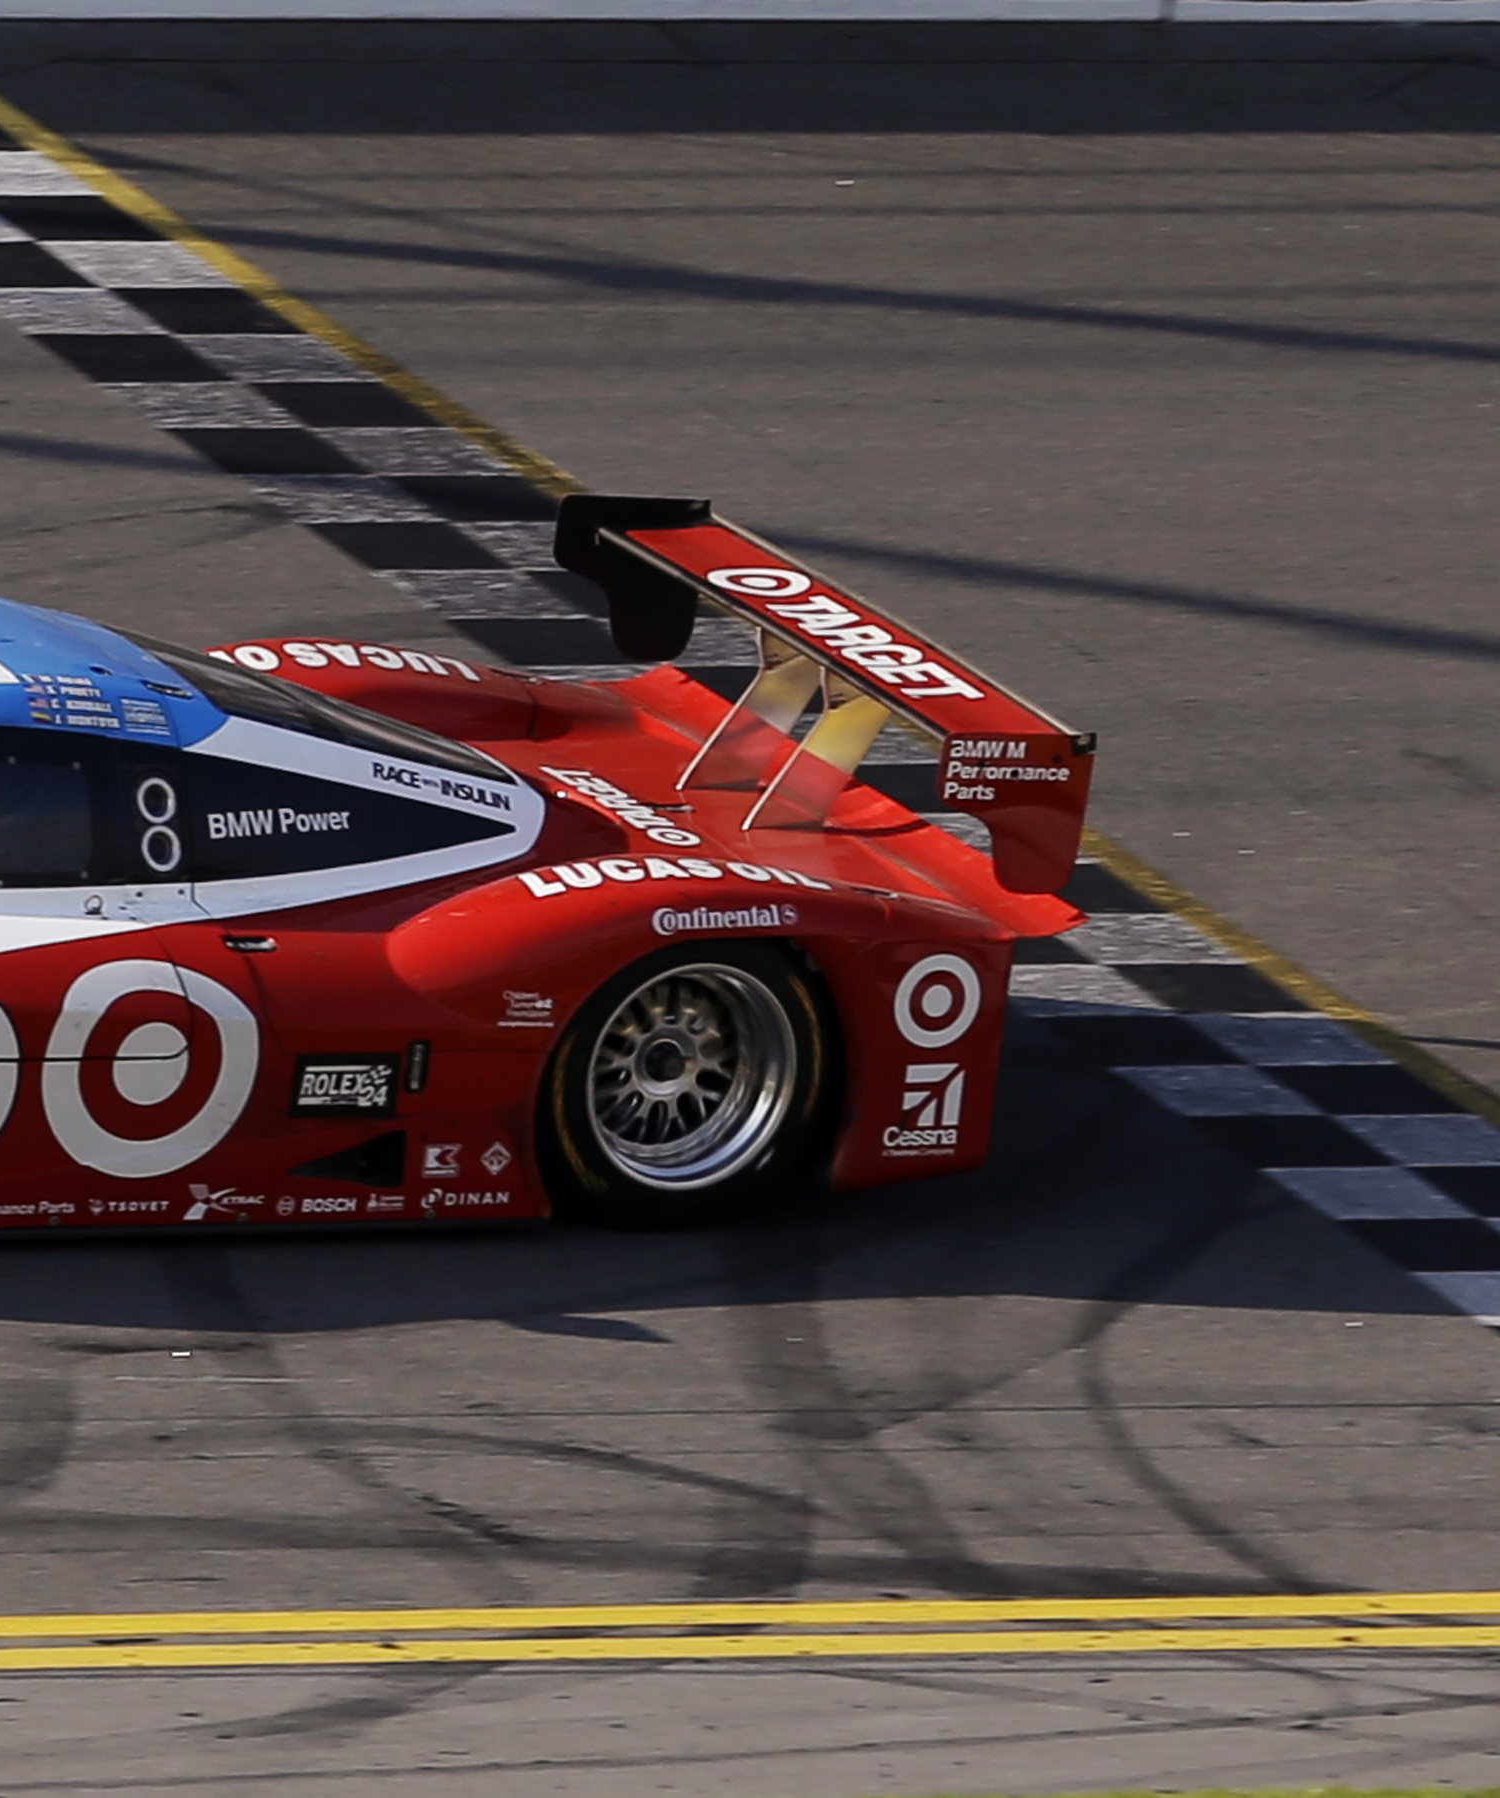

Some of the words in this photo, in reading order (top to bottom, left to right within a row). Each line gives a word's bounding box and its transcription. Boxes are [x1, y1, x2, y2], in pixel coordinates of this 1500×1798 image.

[765, 596, 984, 700] TARGET
[282, 643, 480, 681] LUCAS
[950, 740, 1004, 758] BMW
[1006, 741, 1026, 758] M
[372, 762, 421, 789] RACE
[440, 778, 511, 811] INSULIN
[943, 782, 995, 800] Parts
[207, 809, 273, 839] BMW
[278, 807, 350, 833] Power
[518, 858, 724, 898] LUCAS
[726, 862, 834, 890] OIL
[652, 905, 782, 936] Continental
[300, 1073, 367, 1095] ROLEX
[358, 1085, 389, 1107] 24
[883, 1126, 958, 1147] Cessna
[38, 1200, 77, 1214] Parts
[107, 1200, 170, 1212] TSOVET
[301, 1197, 358, 1214] BOSCH
[444, 1192, 511, 1206] DINAN
